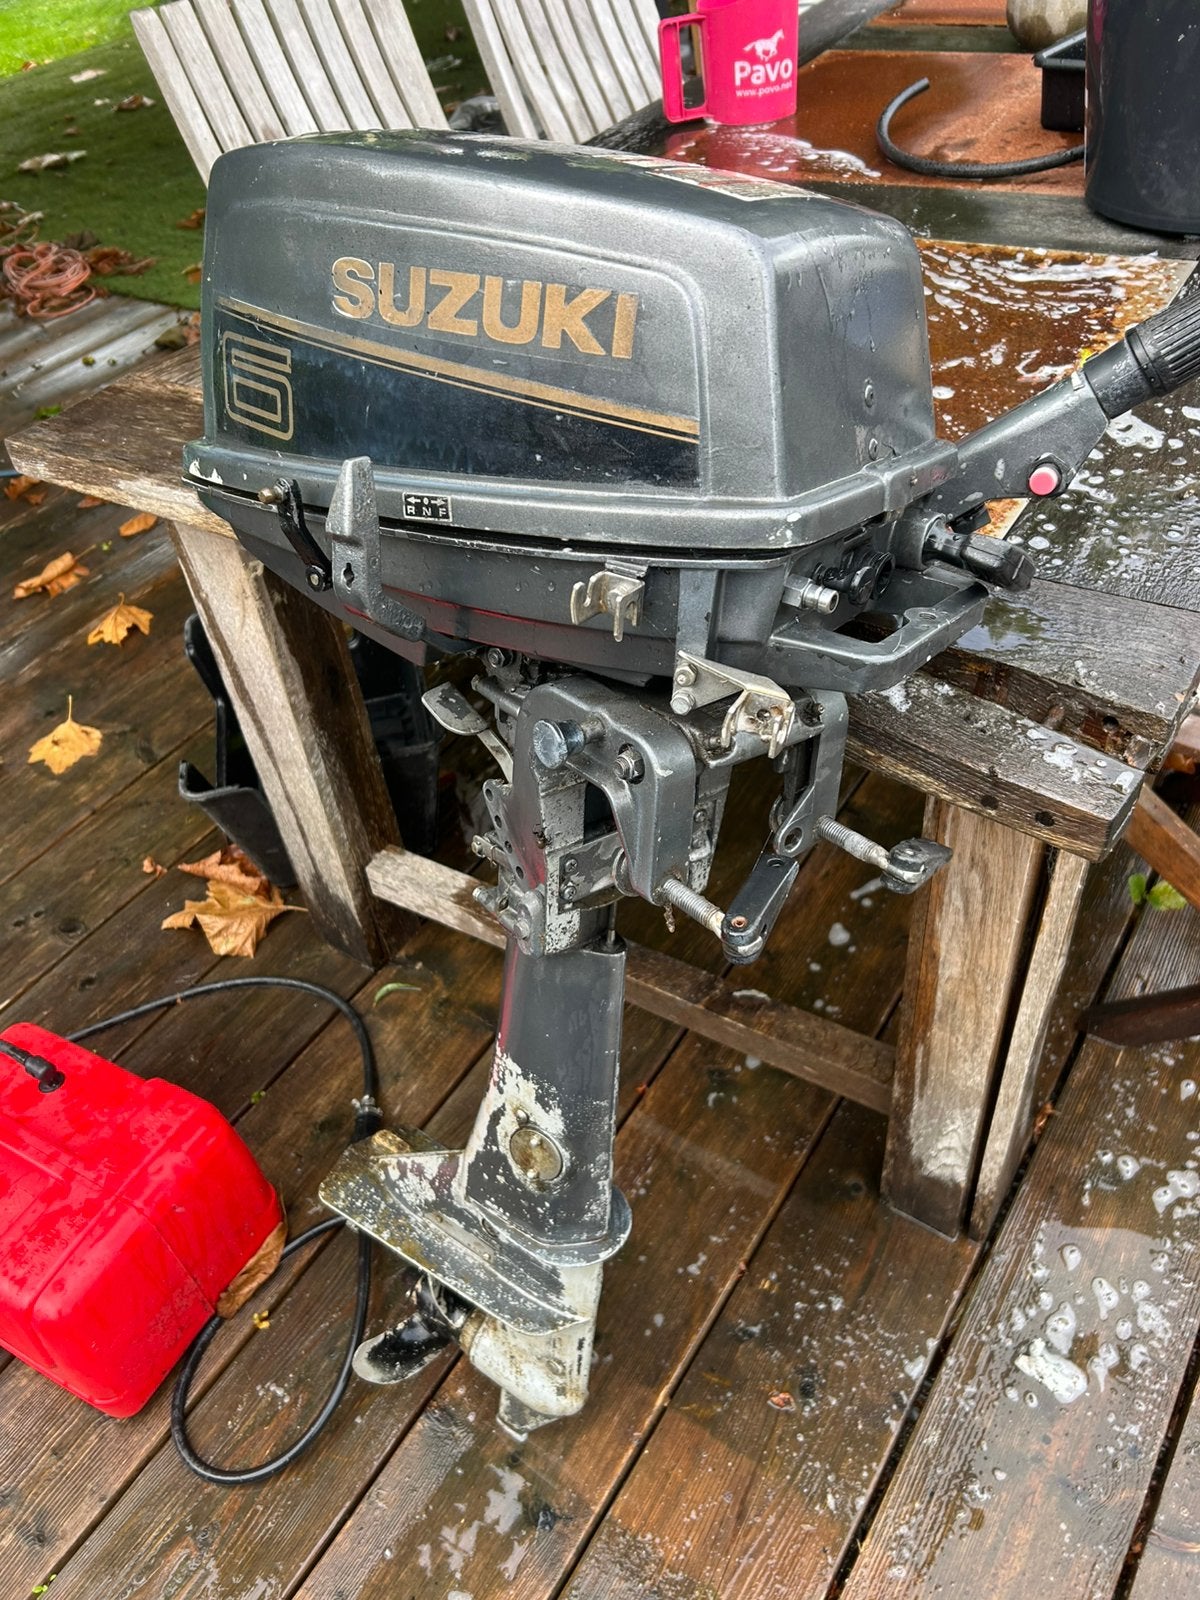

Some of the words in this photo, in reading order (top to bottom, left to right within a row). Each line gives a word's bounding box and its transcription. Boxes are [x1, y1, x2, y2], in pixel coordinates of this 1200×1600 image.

[734, 58, 793, 87] Pavo
[331, 256, 638, 359] SUZUKI
[406, 505, 415, 515] R
[422, 506, 432, 516] N
[438, 507, 447, 517] F
